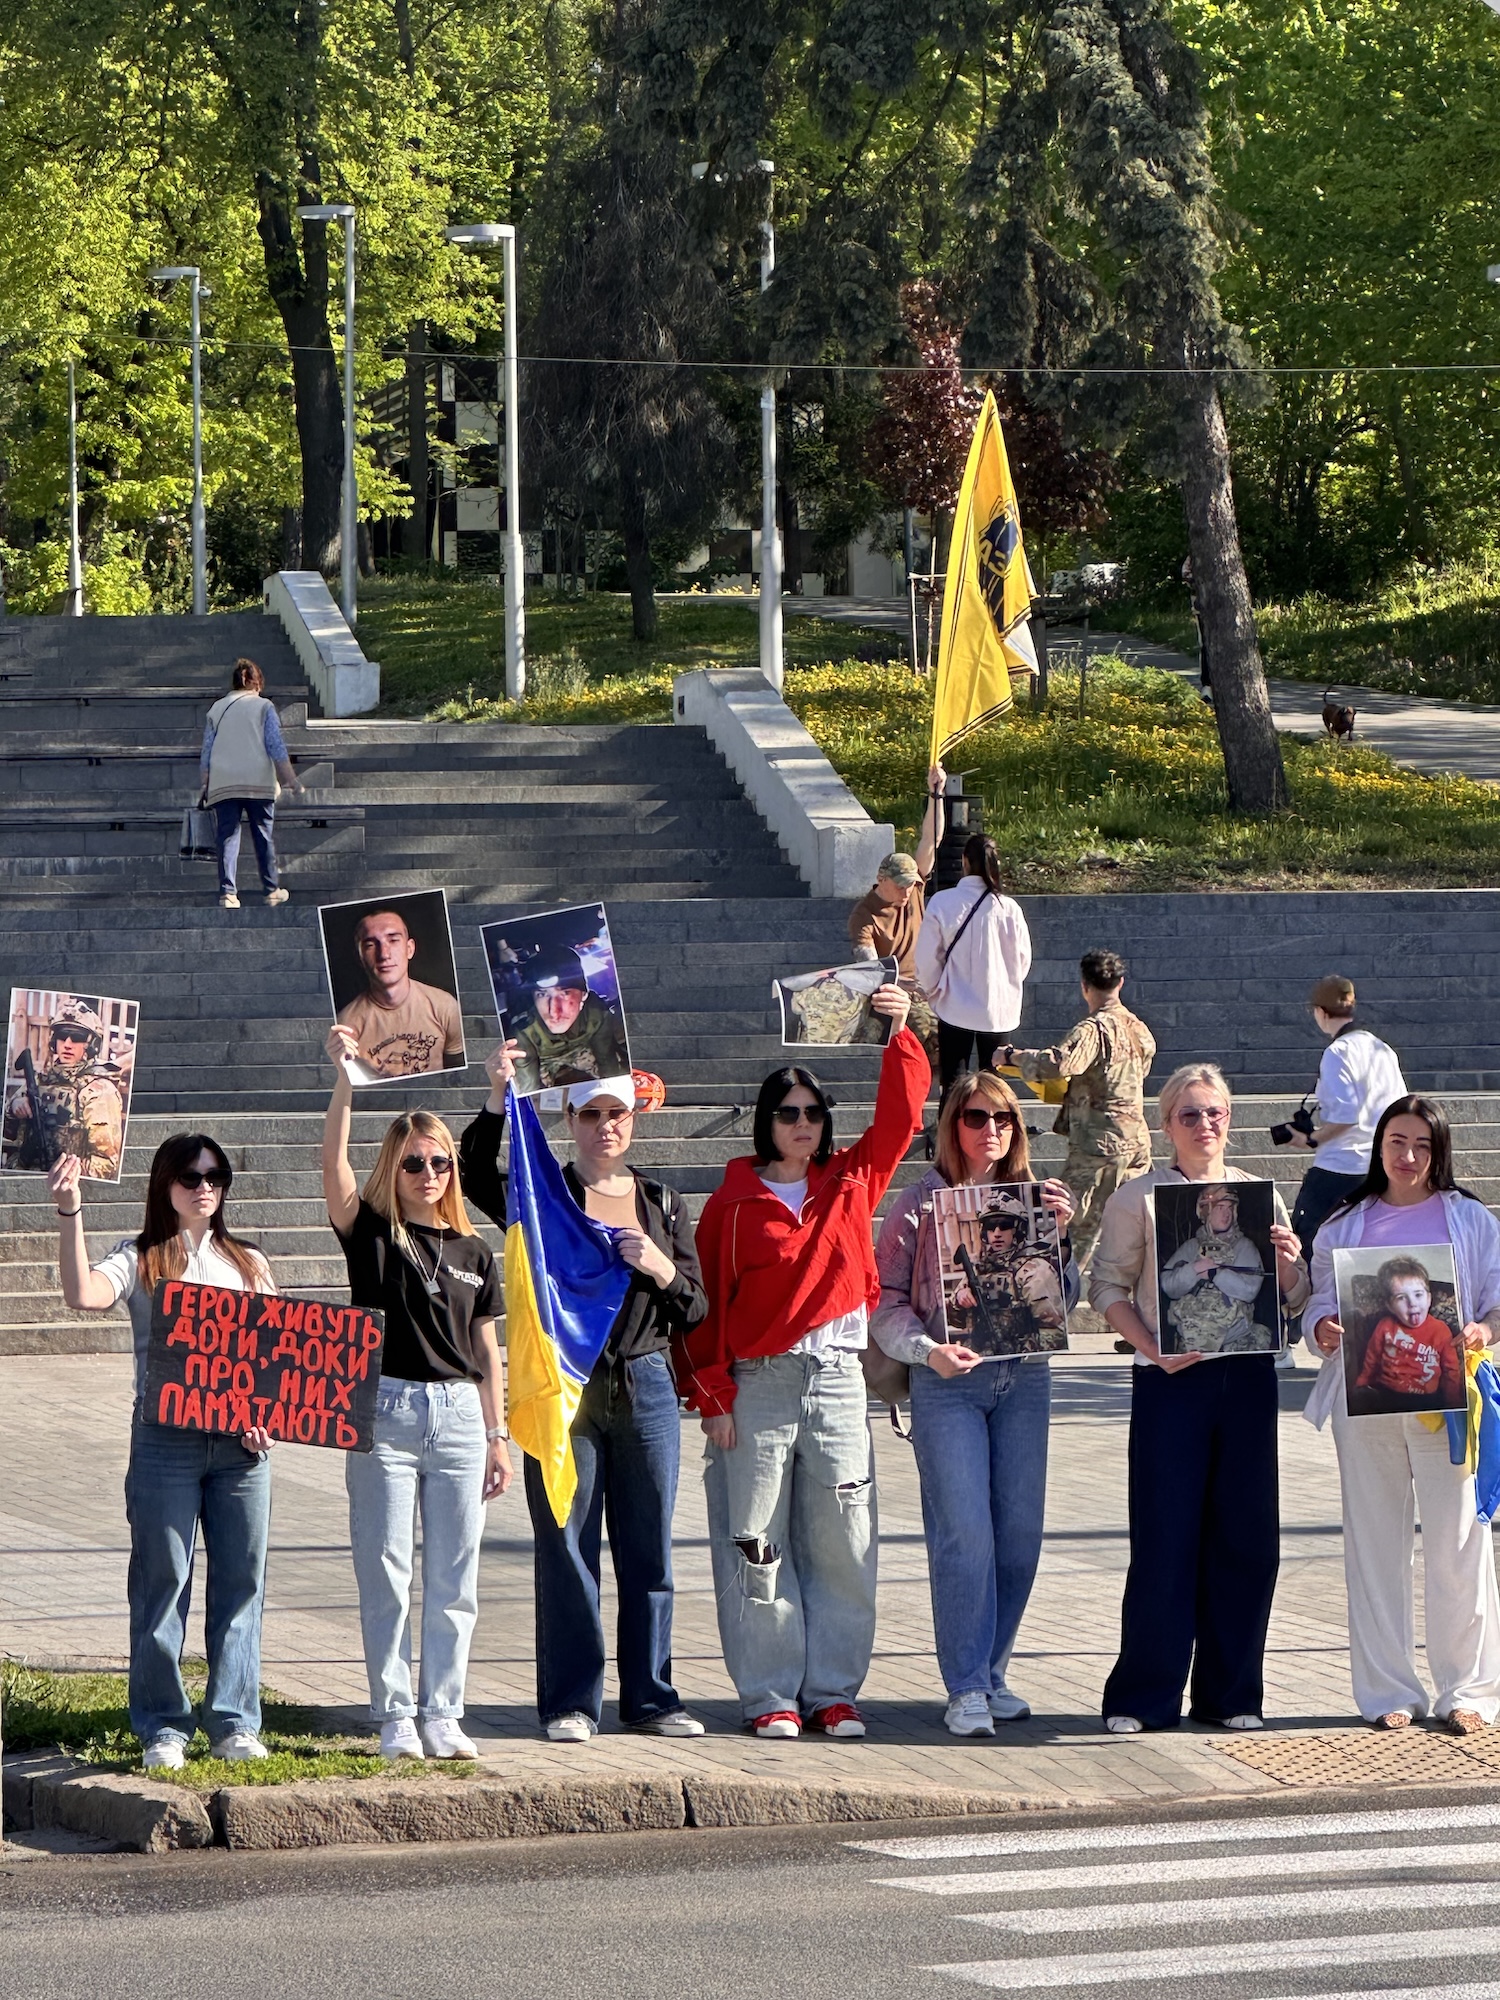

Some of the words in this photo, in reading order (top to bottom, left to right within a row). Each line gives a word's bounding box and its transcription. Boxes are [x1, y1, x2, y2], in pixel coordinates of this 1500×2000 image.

[163, 1281, 255, 1325] ГЕРОЇ
[257, 1297, 382, 1350] ЖИВУТЬ
[166, 1316, 269, 1369] ДОТИ,
[272, 1331, 370, 1381] ДОКИ
[185, 1354, 254, 1397] ПРО
[280, 1369, 356, 1411] НИХ
